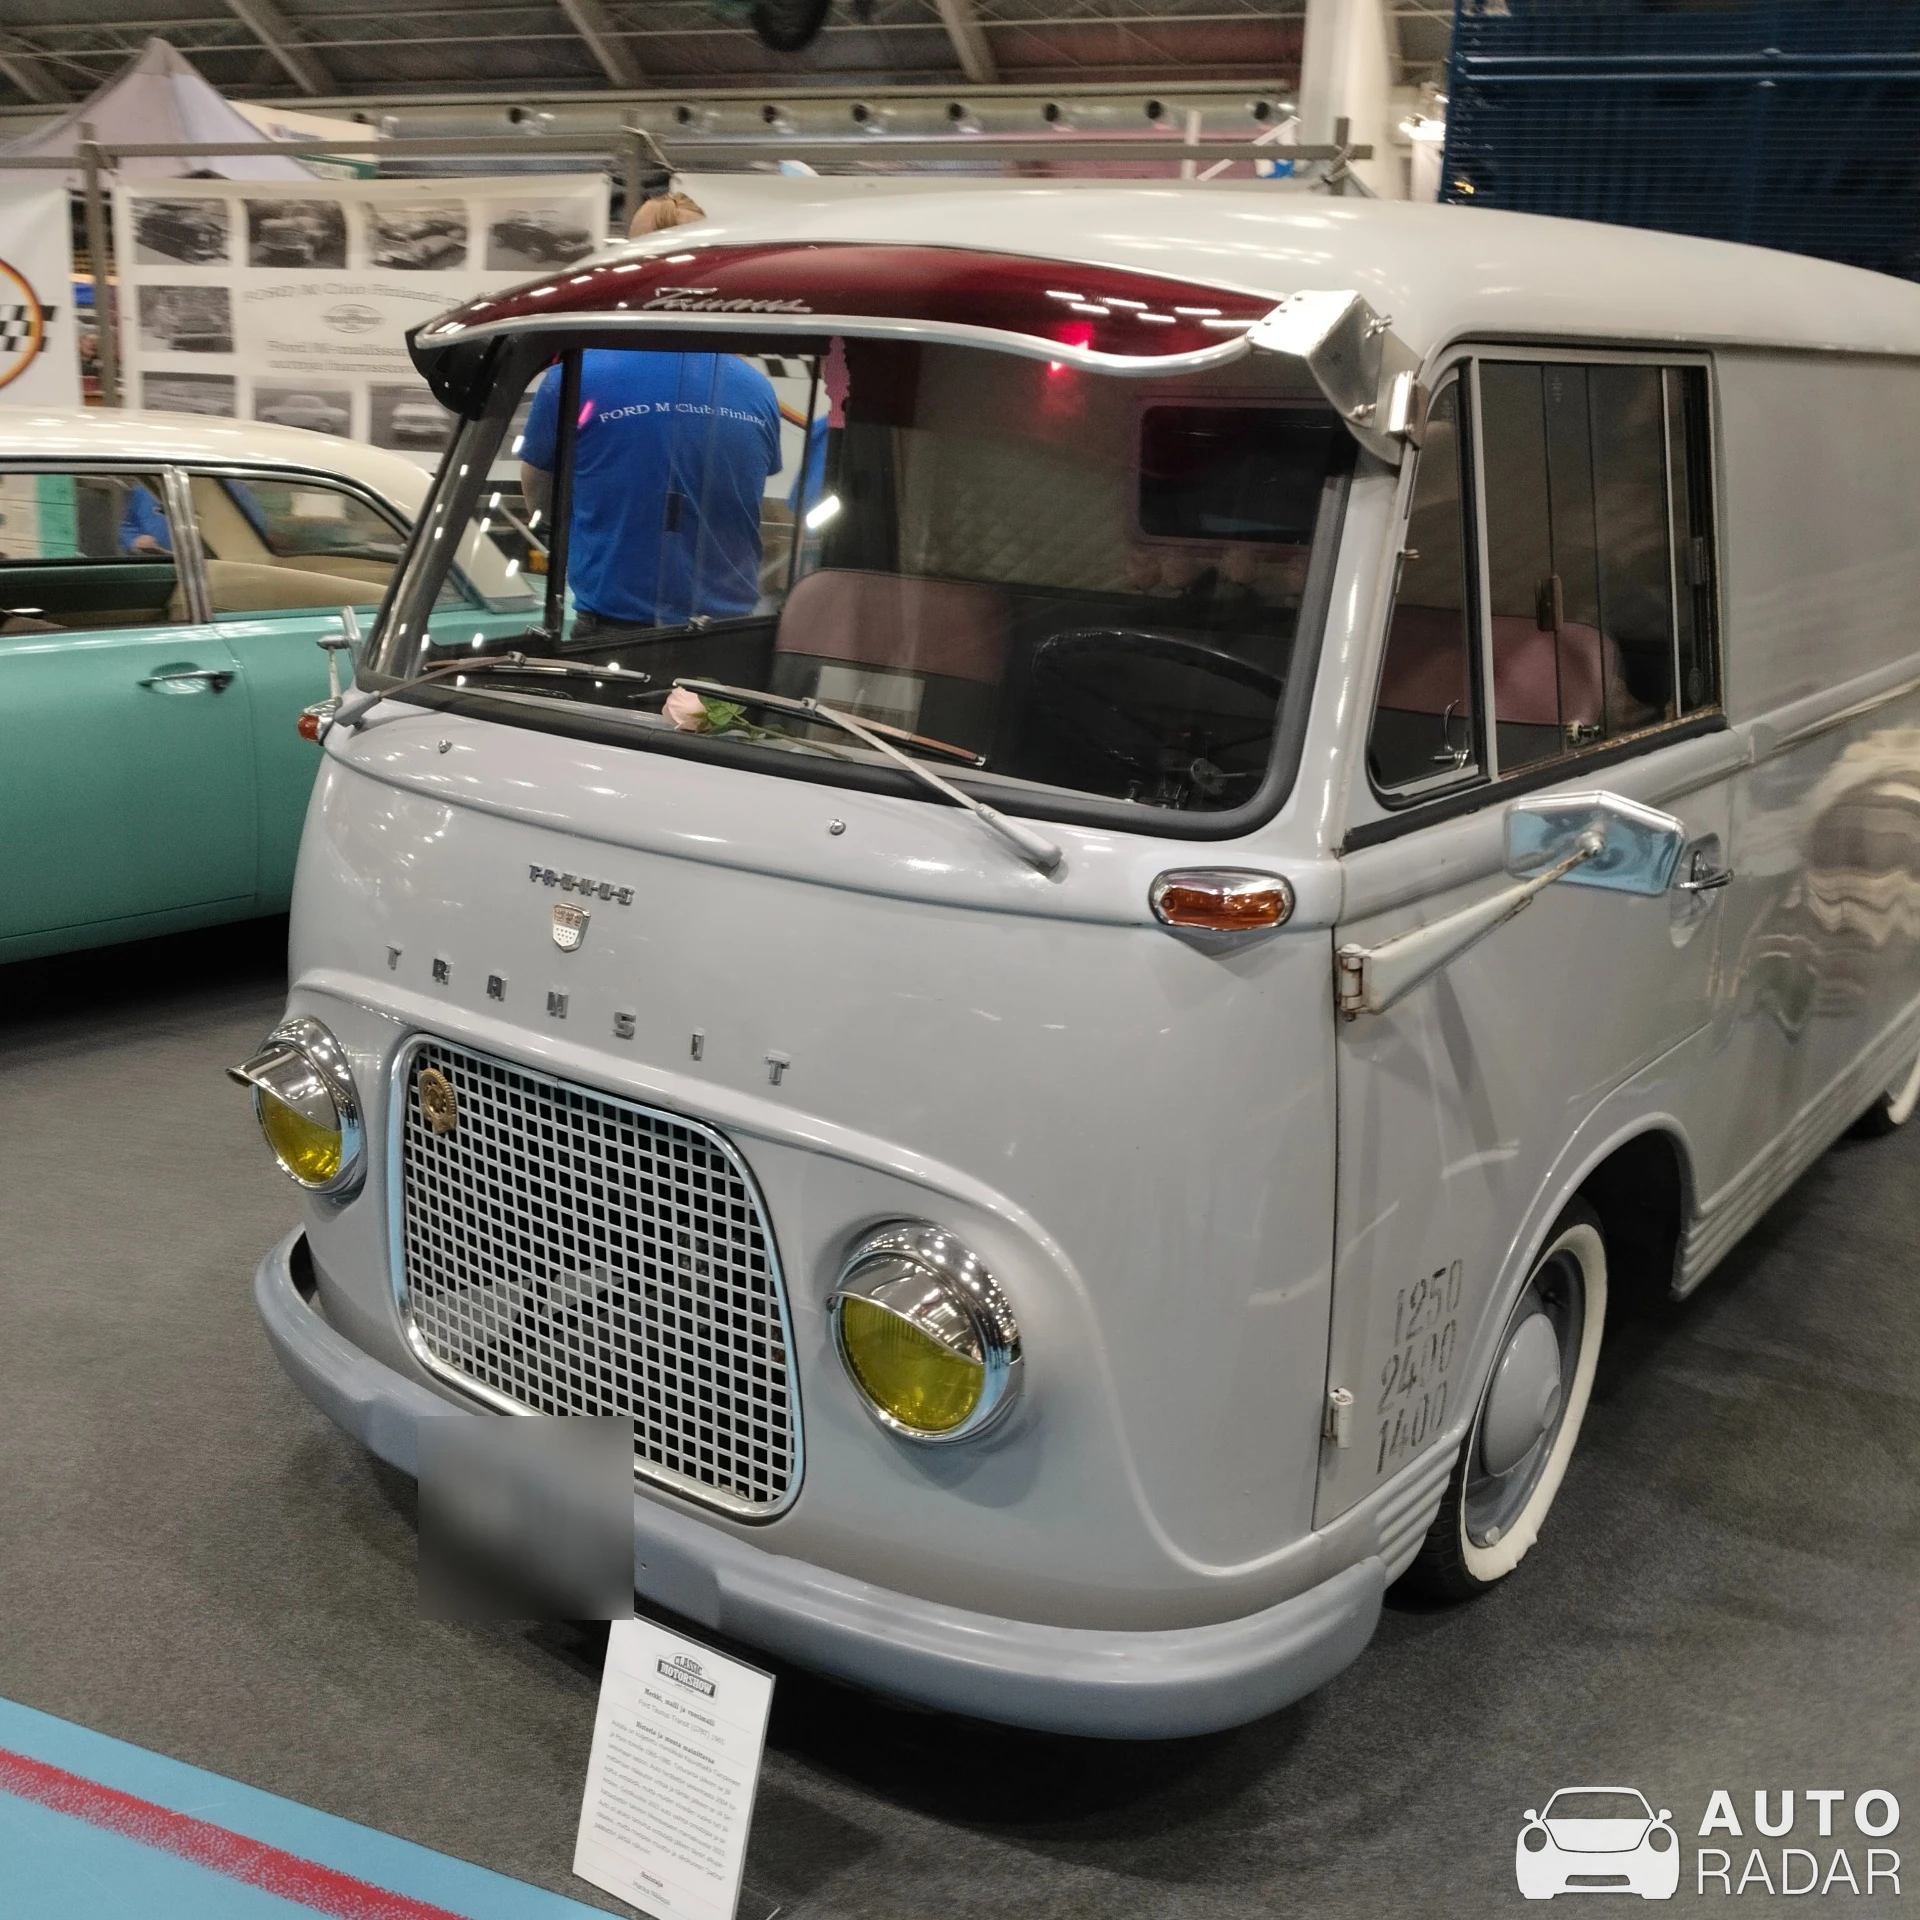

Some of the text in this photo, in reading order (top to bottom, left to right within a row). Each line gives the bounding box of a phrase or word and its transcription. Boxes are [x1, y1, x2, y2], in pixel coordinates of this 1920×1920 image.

[599, 402, 650, 423] FORD
[655, 402, 670, 412] M
[677, 403, 714, 414] Club
[528, 863, 636, 906] TAUNUS
[385, 942, 791, 1087] TRANSIT
[1394, 1259, 1463, 1348] 1250
[1377, 1319, 1457, 1415] 2400
[1376, 1381, 1448, 1474] 1400
[660, 1662, 713, 1695] MOTORSHOW
[674, 1655, 703, 1675] CLASSIC
[644, 1687, 663, 1703] Merkki,
[665, 1699, 679, 1710] malli
